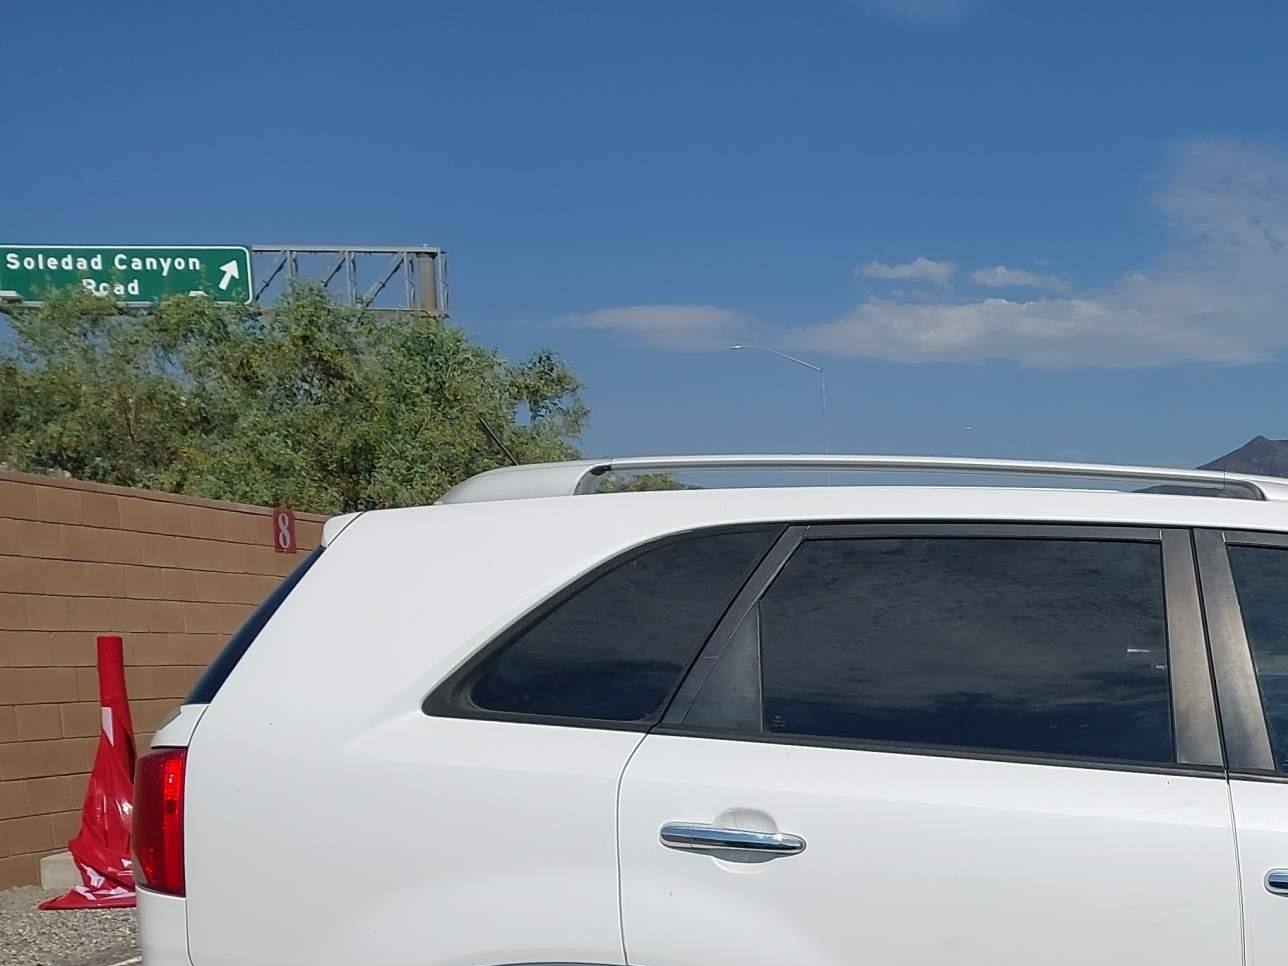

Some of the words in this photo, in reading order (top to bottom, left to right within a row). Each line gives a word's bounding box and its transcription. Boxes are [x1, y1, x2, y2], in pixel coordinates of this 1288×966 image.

[5, 252, 104, 270] Soledad
[113, 252, 202, 277] Canyon
[82, 278, 140, 297] Road
[278, 512, 291, 549] 8
